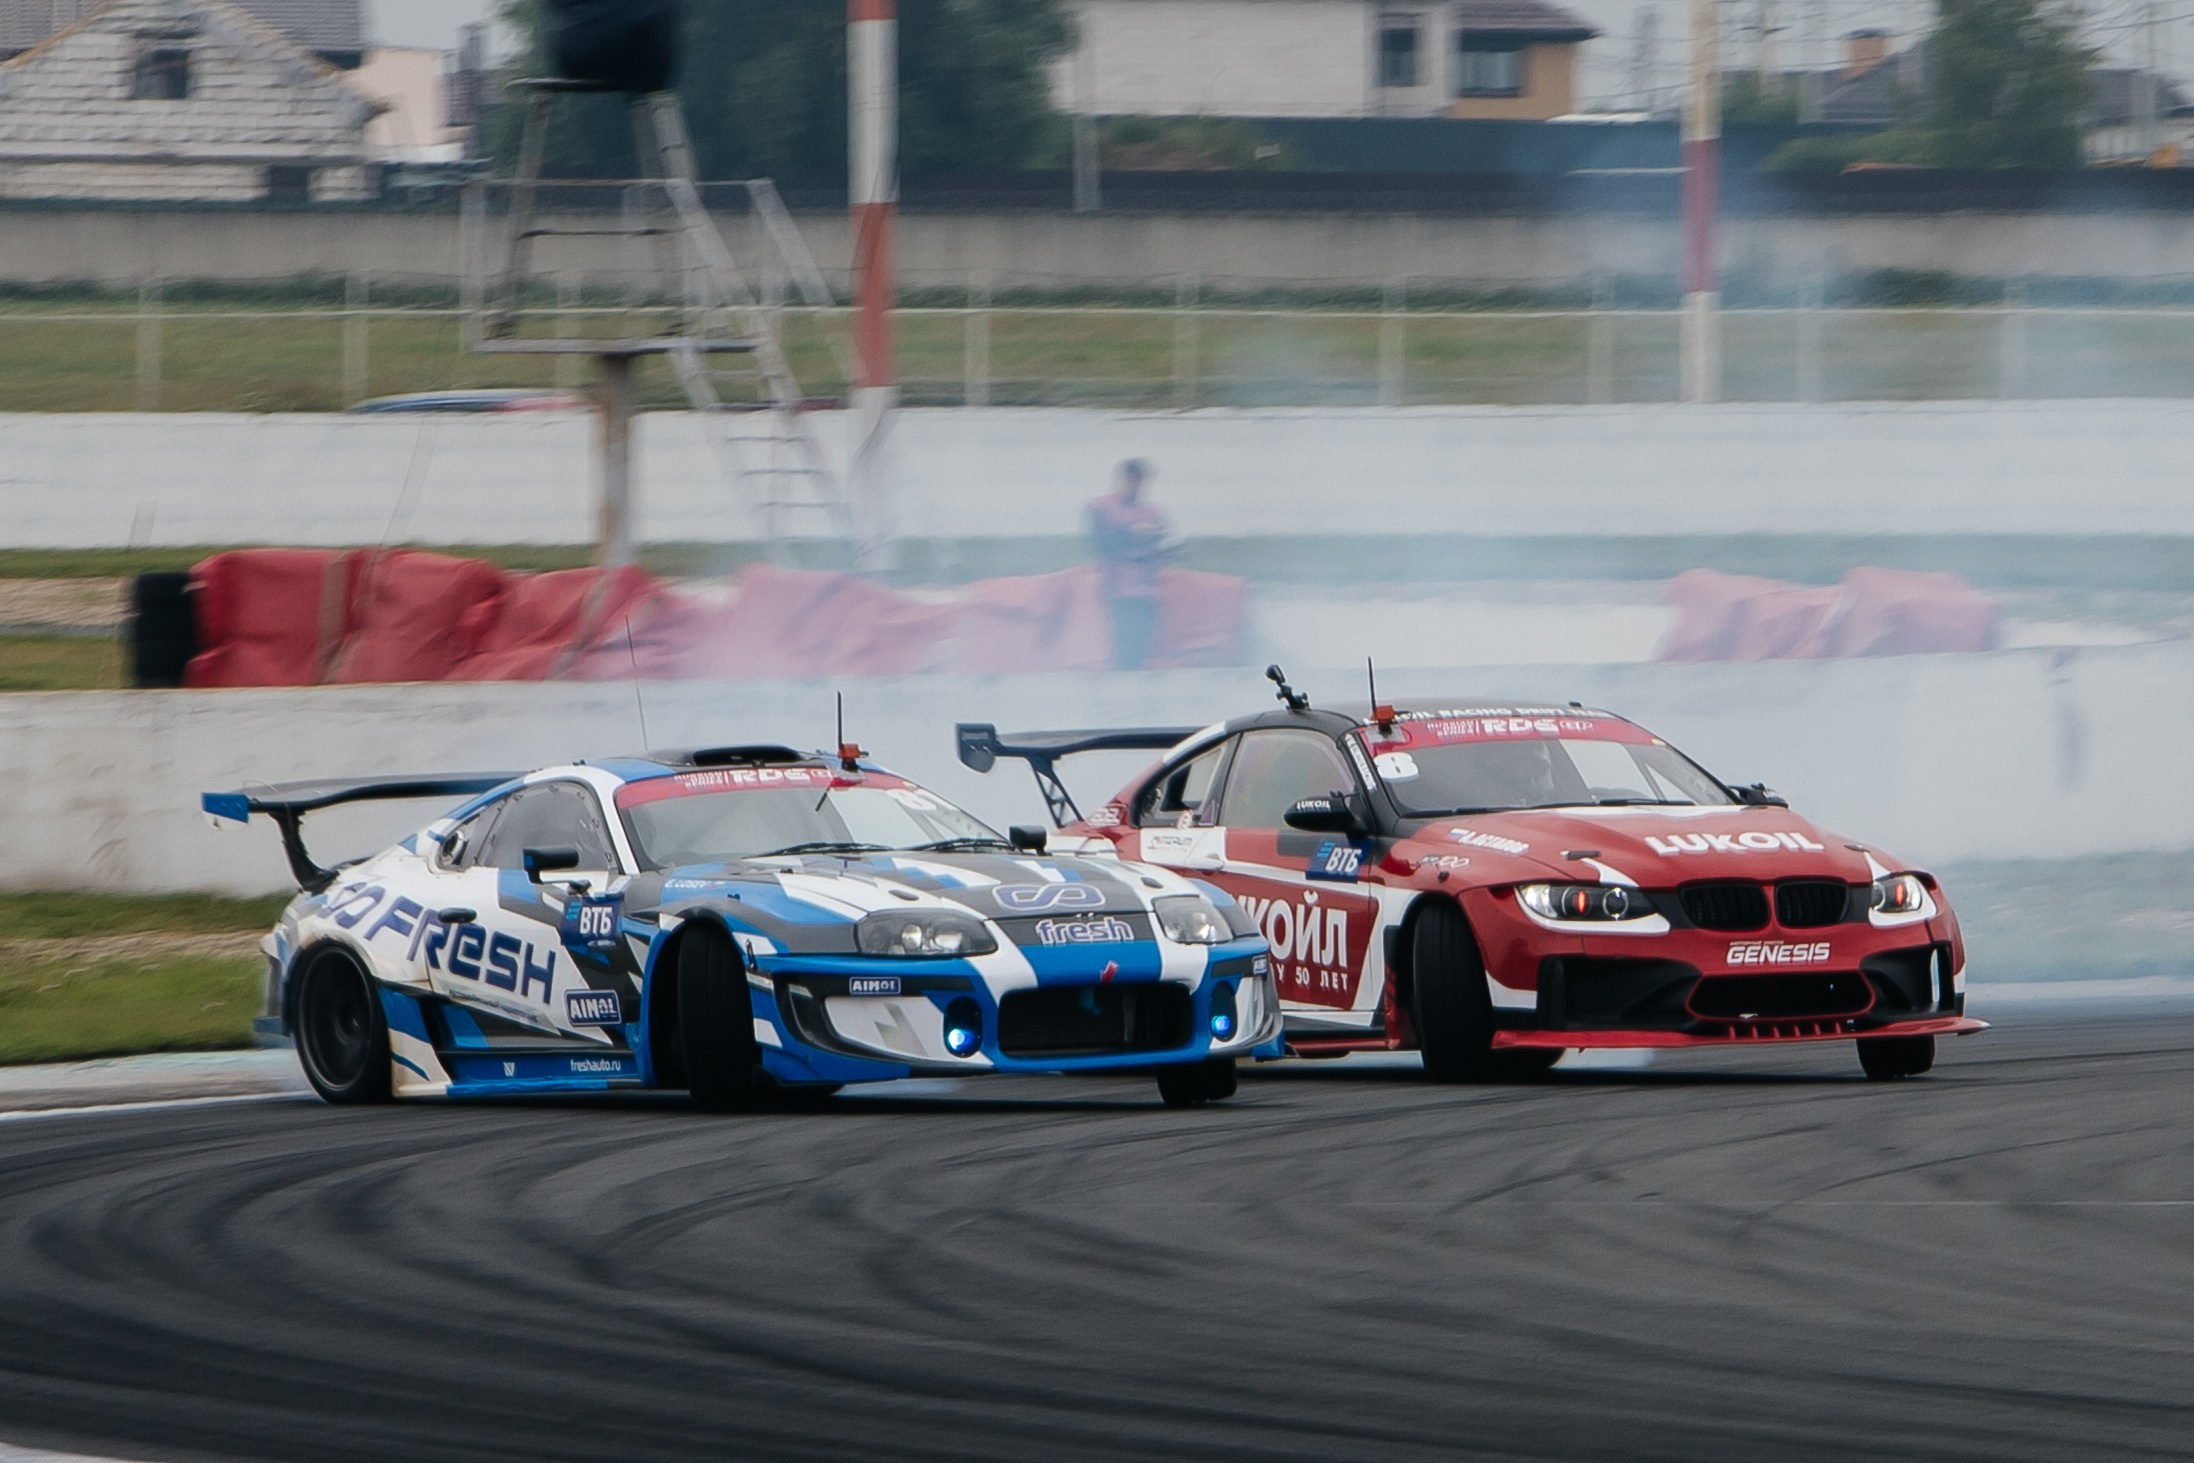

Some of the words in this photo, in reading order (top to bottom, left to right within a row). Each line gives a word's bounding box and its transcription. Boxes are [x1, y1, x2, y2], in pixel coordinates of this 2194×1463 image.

[1480, 718, 1560, 735] RDS
[730, 768, 811, 783] RDS
[1296, 800, 1331, 810] LUKOIL
[1644, 832, 1824, 857] LUKOIL
[1325, 847, 1362, 873] ВТБ
[580, 906, 613, 935] ВТБ
[1035, 916, 1135, 946] fresh
[1238, 889, 1347, 968] КОЙЛ
[1726, 942, 1831, 964] GENESIS
[1295, 967, 1310, 987] 50
[1320, 970, 1348, 993] ЛЕТ
[570, 1059, 621, 1072] freshauto.ru
